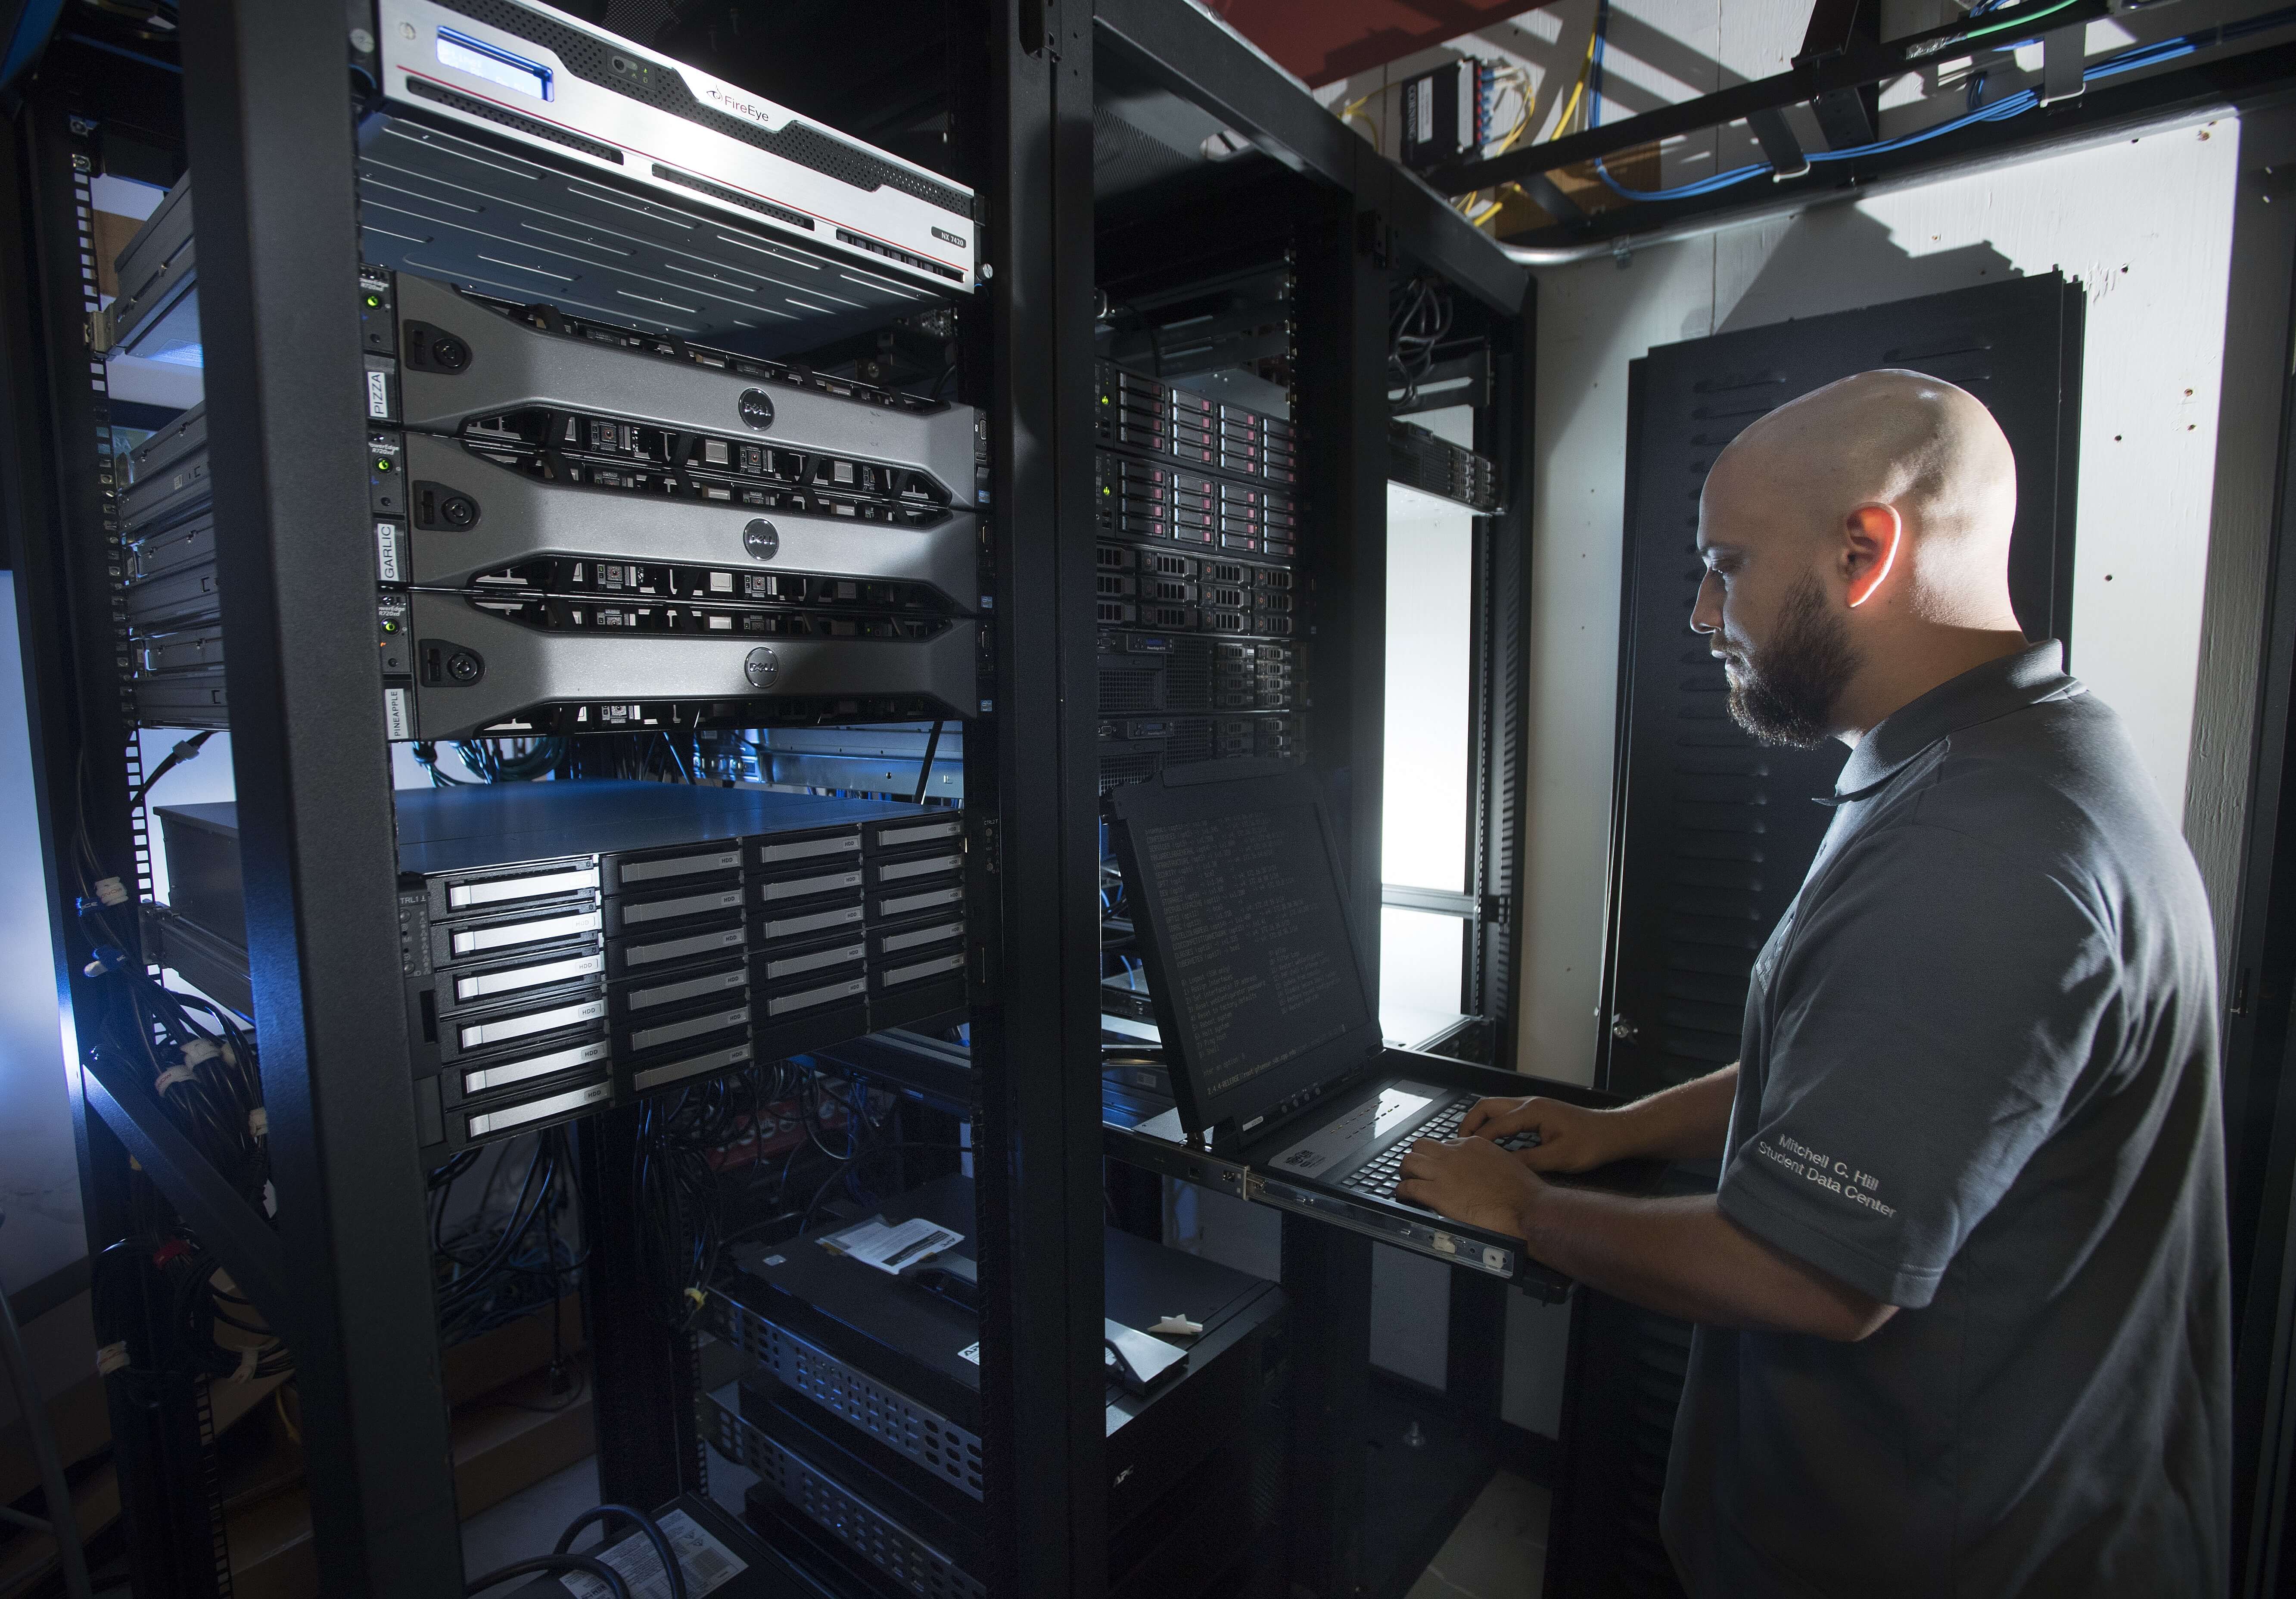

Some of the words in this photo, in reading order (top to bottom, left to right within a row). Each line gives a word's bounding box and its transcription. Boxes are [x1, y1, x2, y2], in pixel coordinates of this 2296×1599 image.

[725, 95, 769, 121] FireEye
[1406, 85, 1417, 139] CORNING
[941, 231, 950, 241] NX
[951, 234, 964, 246] 7420
[373, 373, 386, 415] PIZZA
[744, 402, 771, 417] DELL
[748, 533, 775, 545] DELL
[382, 526, 395, 579] GARLIC
[749, 662, 777, 673] DELL
[390, 691, 401, 737] PINEAPPLE
[399, 896, 418, 904] TRL1
[579, 961, 593, 970] HDD
[582, 1007, 596, 1015] HDD
[585, 1048, 598, 1057] HDD
[588, 1088, 602, 1098] HDD
[1779, 1133, 1829, 1169] Mitchell
[1834, 1162, 1849, 1178] C.
[1854, 1170, 1879, 1191] Hill
[1758, 1141, 1804, 1176] Student
[1806, 1168, 1842, 1194] Data
[1844, 1185, 1897, 1218] Center
